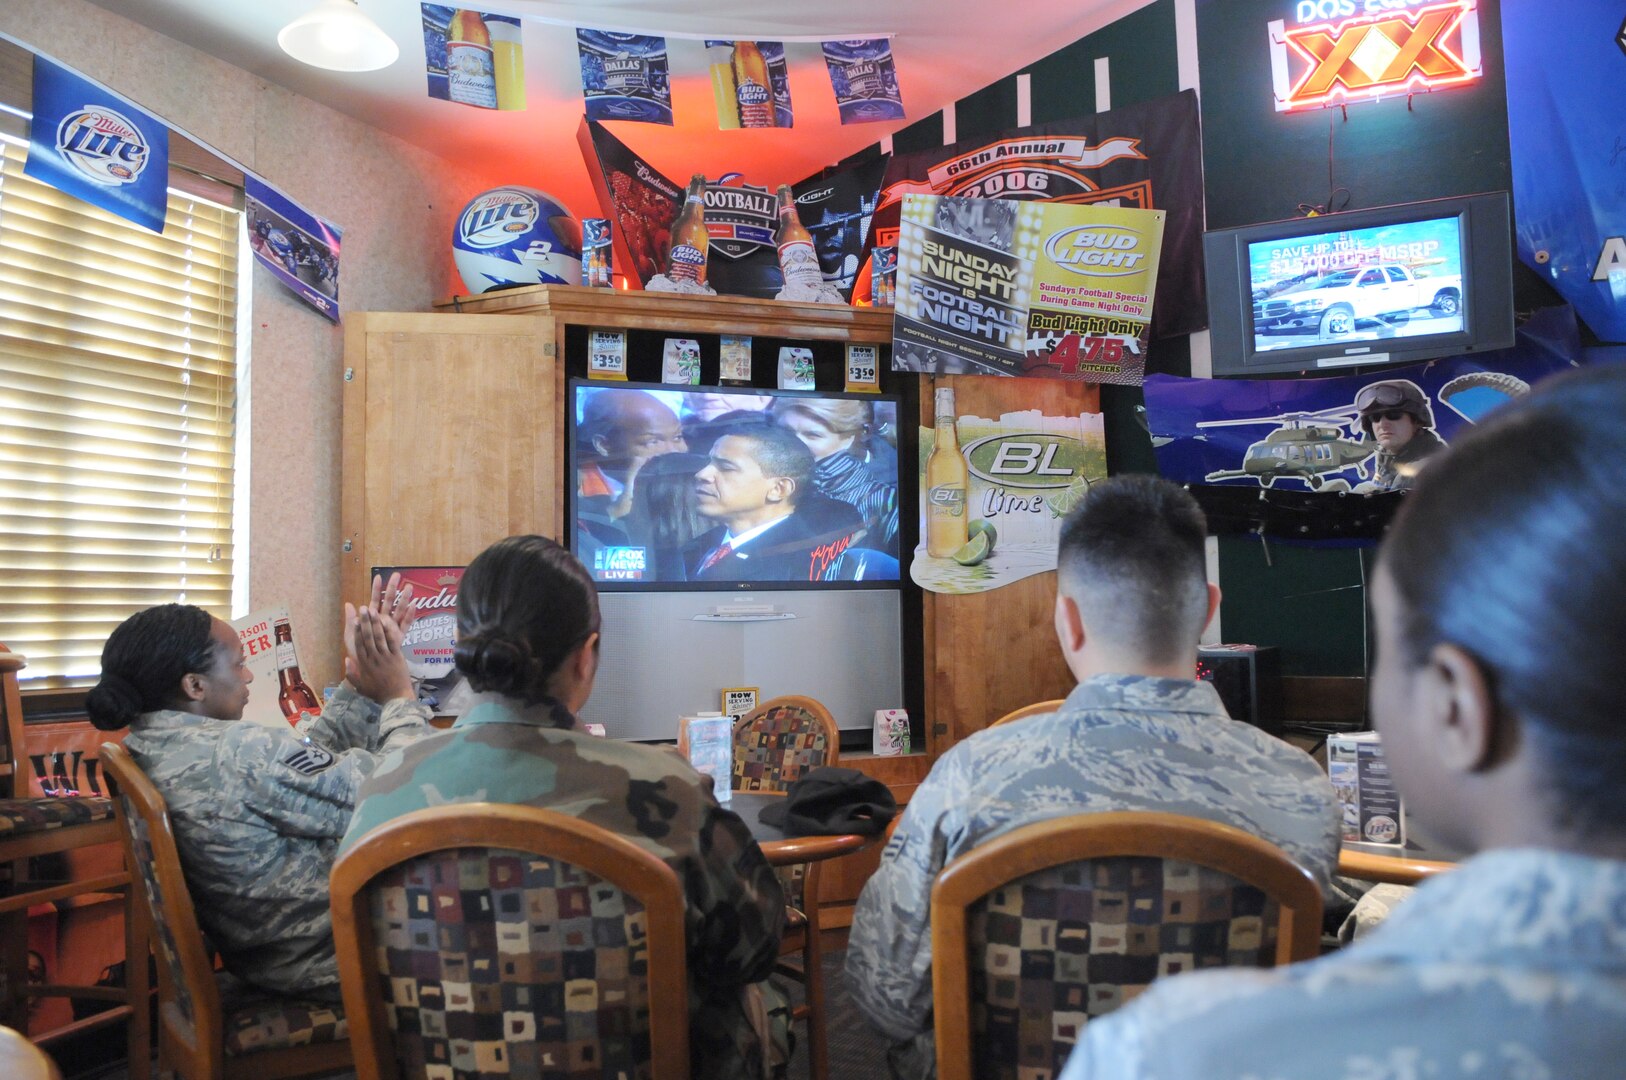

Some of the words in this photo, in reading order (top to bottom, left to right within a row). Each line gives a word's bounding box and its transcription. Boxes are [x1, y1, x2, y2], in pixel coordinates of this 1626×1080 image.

[604, 60, 641, 72] DALLAS
[846, 63, 875, 79] DALLAS
[739, 92, 768, 100] LIGHT
[91, 112, 137, 137] Miller
[63, 123, 146, 162] Lite
[946, 152, 991, 176] 66th
[996, 142, 1066, 158] Annual
[634, 160, 679, 199] Budweiser
[963, 171, 1049, 199] 2006
[703, 191, 771, 214] OOTBALL
[802, 187, 834, 201] LIGHT
[466, 202, 534, 238] Lite
[524, 240, 552, 261] 2
[676, 246, 702, 257] BUD
[1072, 232, 1139, 251] BUD
[1271, 244, 1312, 260] SAVE
[1312, 241, 1331, 255] UP
[1332, 238, 1348, 251] TO
[1380, 240, 1439, 262] MSRP
[672, 252, 704, 264] LIGHT
[922, 239, 1018, 281] SUNDAY
[1055, 248, 1145, 269] LIGHT
[921, 254, 1018, 300] NIGHT
[962, 287, 977, 300] IS
[1039, 282, 1076, 295] Sundays
[1078, 287, 1113, 299] Football
[1115, 291, 1148, 303] Special
[909, 281, 1022, 327] FOOTBALL
[1040, 294, 1069, 306] During
[1071, 297, 1095, 308] Game
[1098, 301, 1121, 312] Night
[1122, 304, 1143, 316] Only
[917, 299, 1013, 343] NIGHT
[1031, 313, 1062, 329] Bud
[1064, 315, 1105, 335] Light
[1108, 319, 1143, 338] Only
[598, 332, 620, 340] NOW
[903, 327, 937, 342] FOOTBALL
[938, 338, 958, 348] NIGHT
[1081, 363, 1121, 373] PITCHERS
[990, 441, 1074, 476] BL
[933, 489, 960, 501] BL
[982, 487, 1043, 518] Lime
[610, 559, 646, 570] NEWS
[617, 549, 644, 560] FOX
[605, 571, 634, 579] LIVE
[239, 621, 268, 640] ASON
[413, 625, 456, 644] FORC
[241, 634, 272, 656] ER
